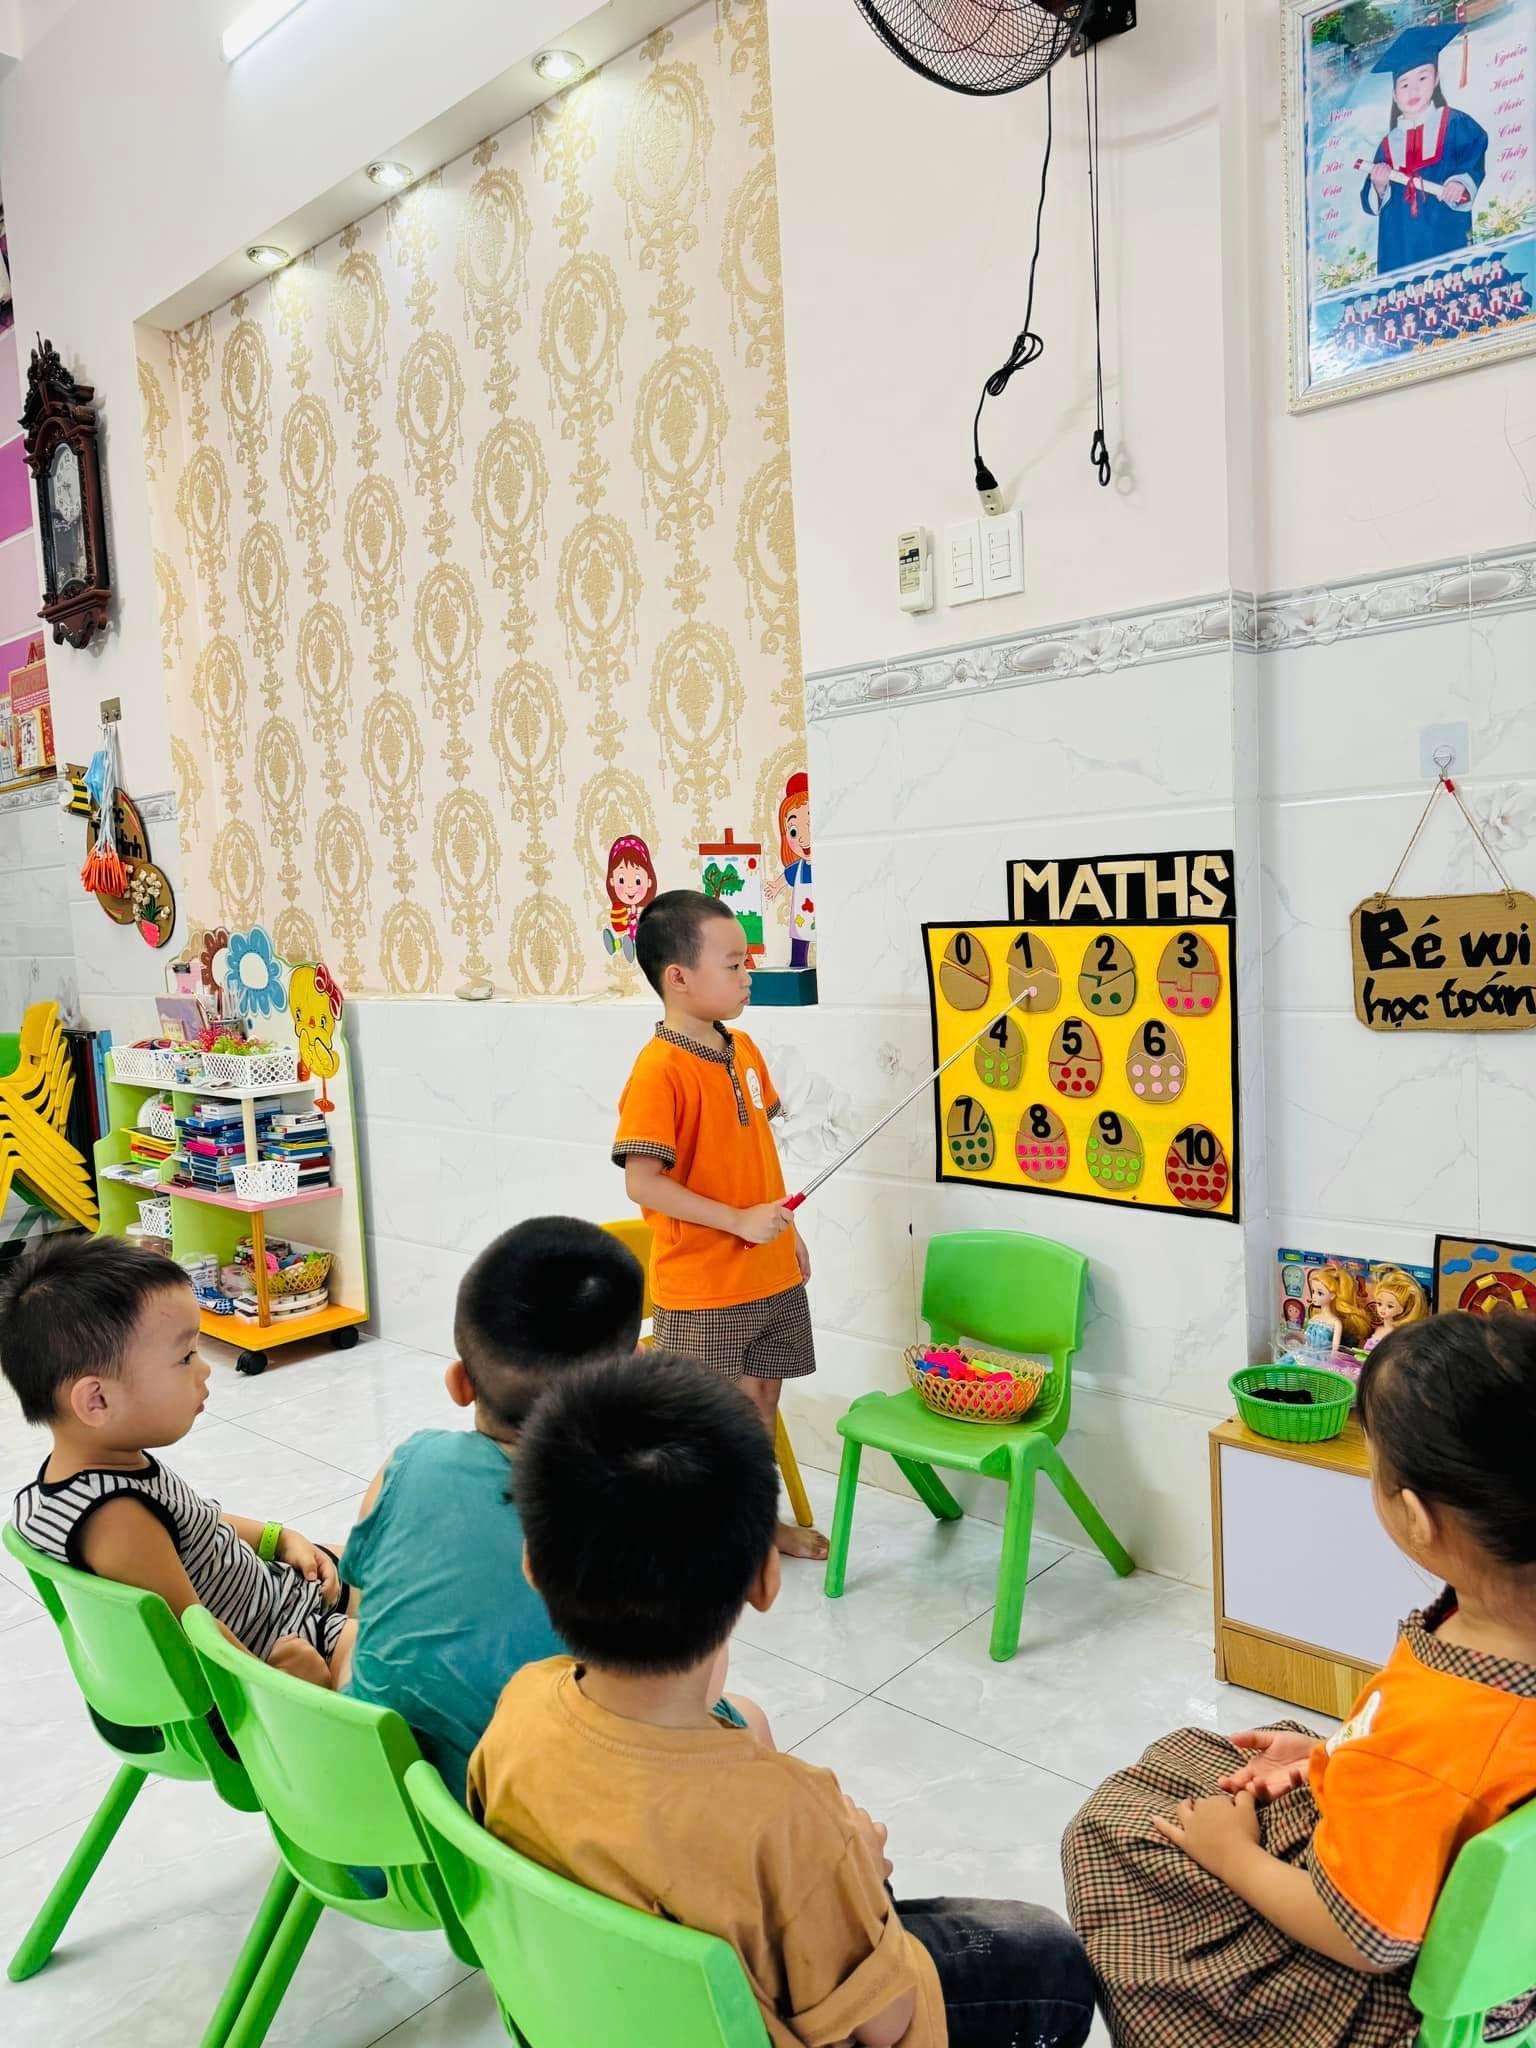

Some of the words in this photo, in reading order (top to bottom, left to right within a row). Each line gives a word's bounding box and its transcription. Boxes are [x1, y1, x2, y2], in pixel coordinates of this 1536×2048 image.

[1013, 855, 1230, 920] MATHS
[955, 933, 971, 965] 0
[1015, 933, 1033, 968] 1
[1096, 936, 1117, 971] 2
[1177, 933, 1199, 968] 3
[1361, 908, 1446, 971] Bé
[1460, 923, 1531, 967] vui
[1363, 977, 1429, 1027] học
[1436, 971, 1536, 1018] toán
[989, 1015, 1008, 1048] 4
[1062, 1021, 1082, 1056] 5
[1143, 1021, 1166, 1056] 6
[955, 1097, 973, 1132] 7
[1029, 1104, 1051, 1138] 8
[1099, 1111, 1123, 1145] 9
[1176, 1128, 1216, 1166] 10
